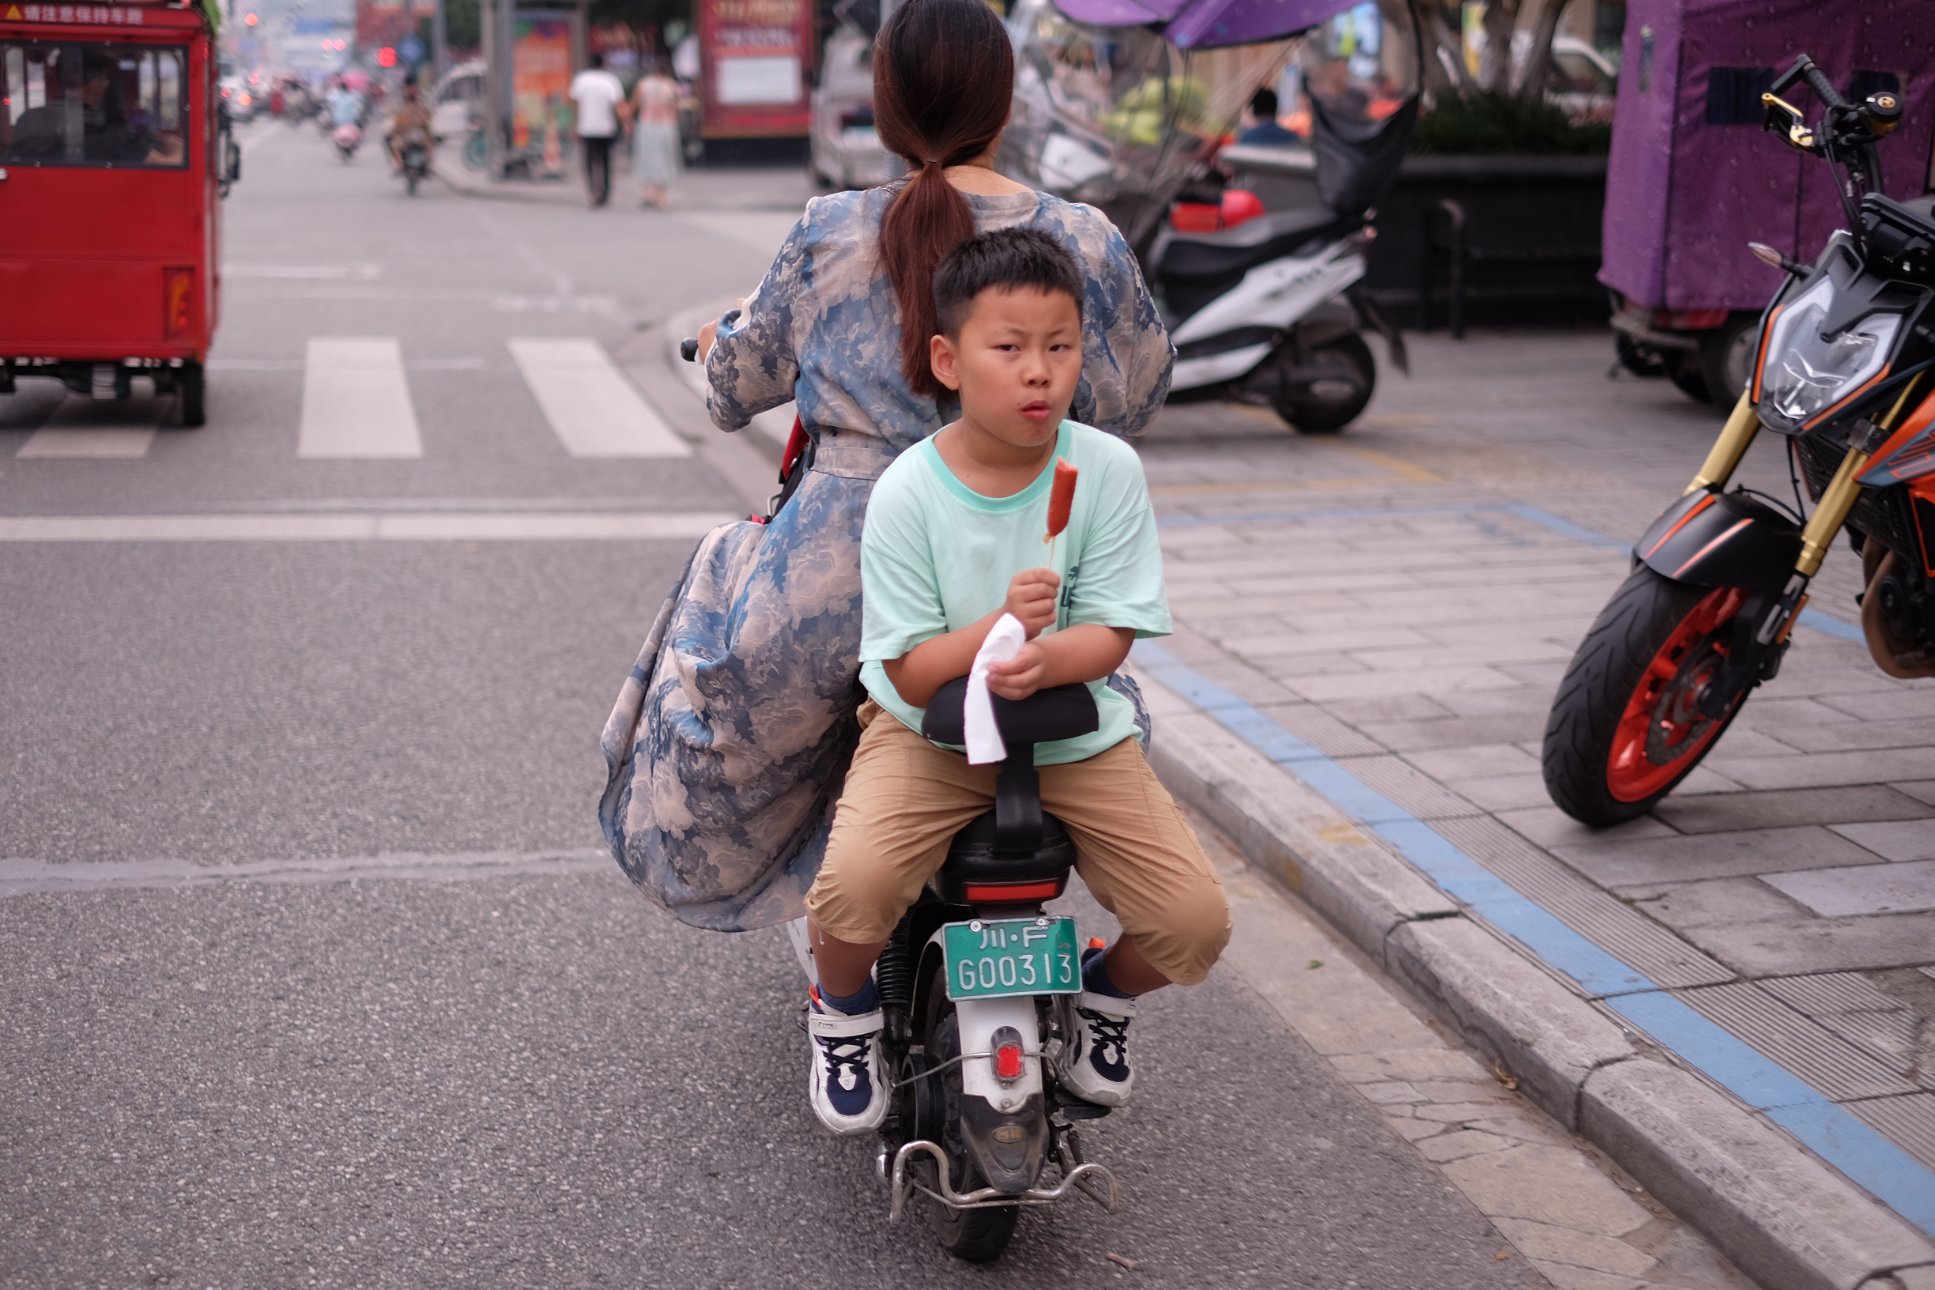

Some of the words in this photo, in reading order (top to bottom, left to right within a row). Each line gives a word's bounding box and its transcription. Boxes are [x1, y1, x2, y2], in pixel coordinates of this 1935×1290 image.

[24, 5, 144, 25] 请注意保持车距
[958, 953, 1072, 991] G00313
